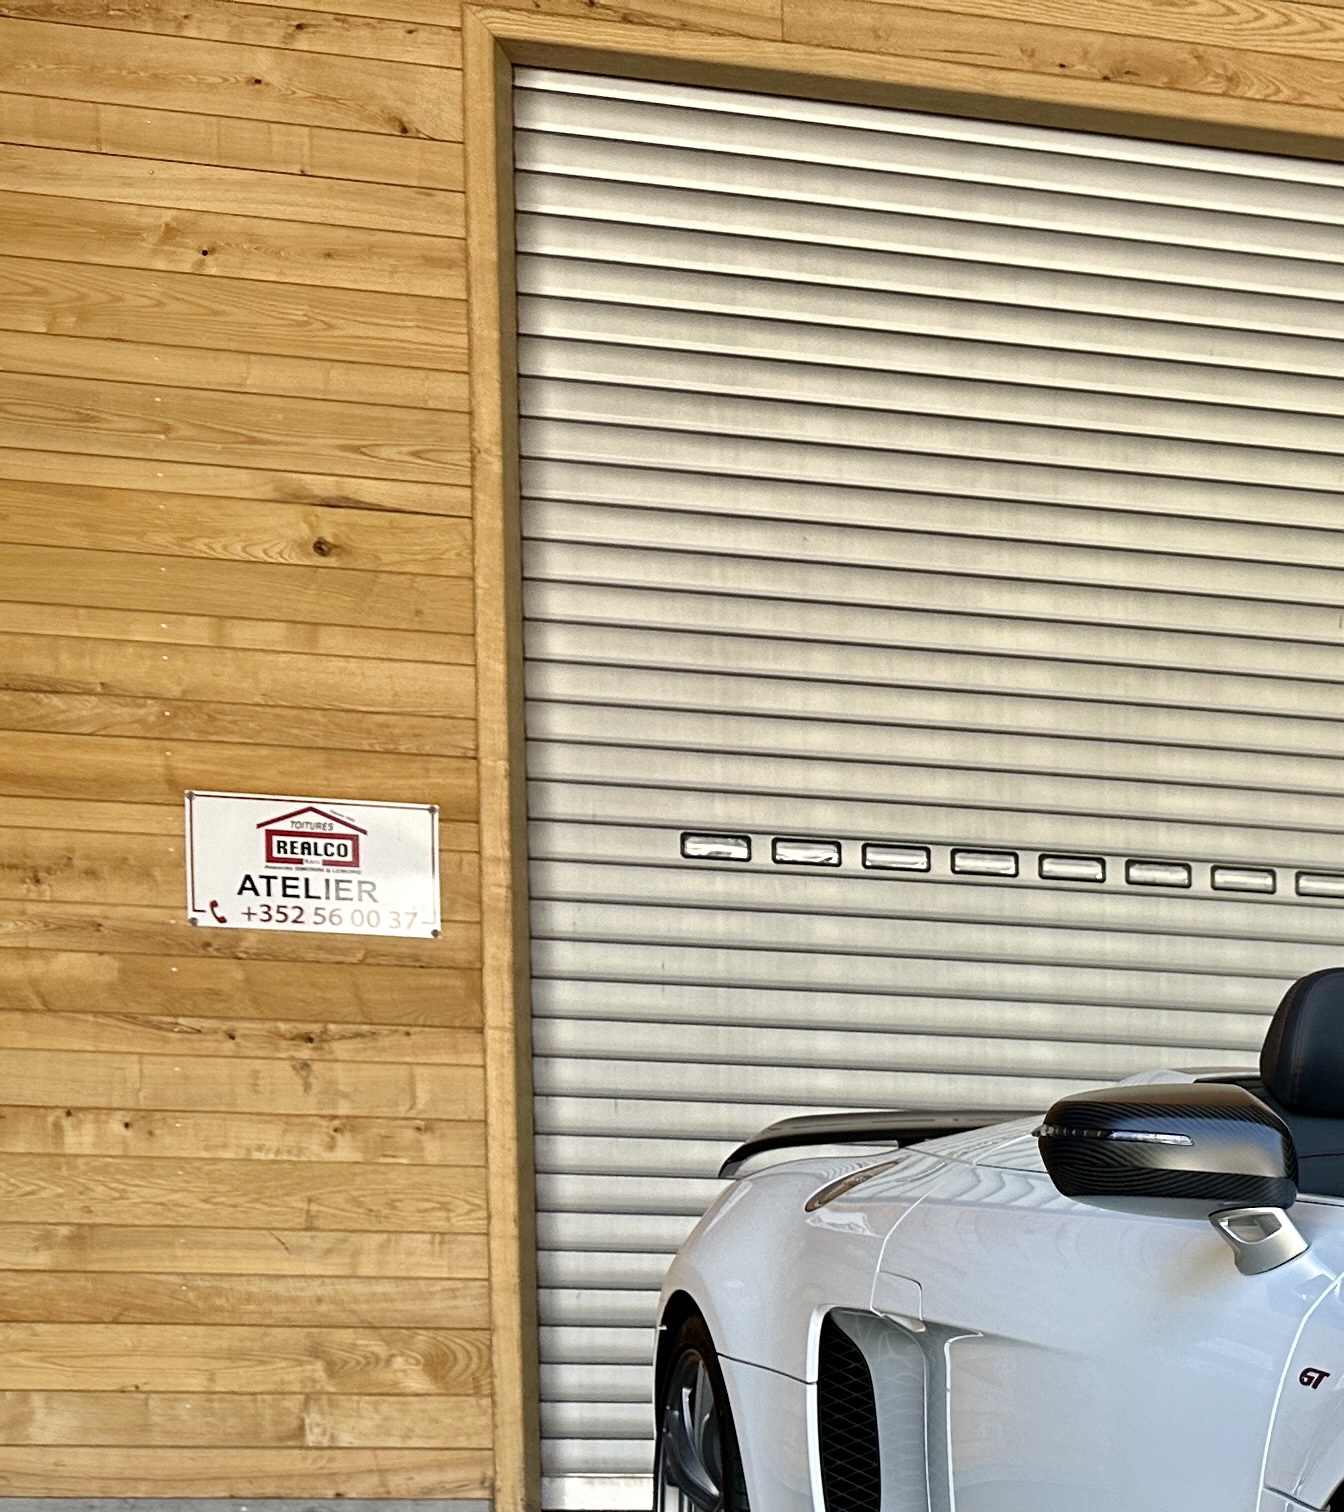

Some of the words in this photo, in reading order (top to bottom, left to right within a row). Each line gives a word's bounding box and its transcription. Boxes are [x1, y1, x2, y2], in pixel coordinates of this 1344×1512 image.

[290, 820, 334, 831] TOITURES
[276, 840, 348, 858] REALCO
[237, 873, 379, 903] ATELIER
[241, 904, 305, 924] +352
[313, 906, 343, 926] 56
[351, 908, 380, 928] 00
[388, 911, 418, 929] 37
[1299, 1367, 1330, 1390] GT
